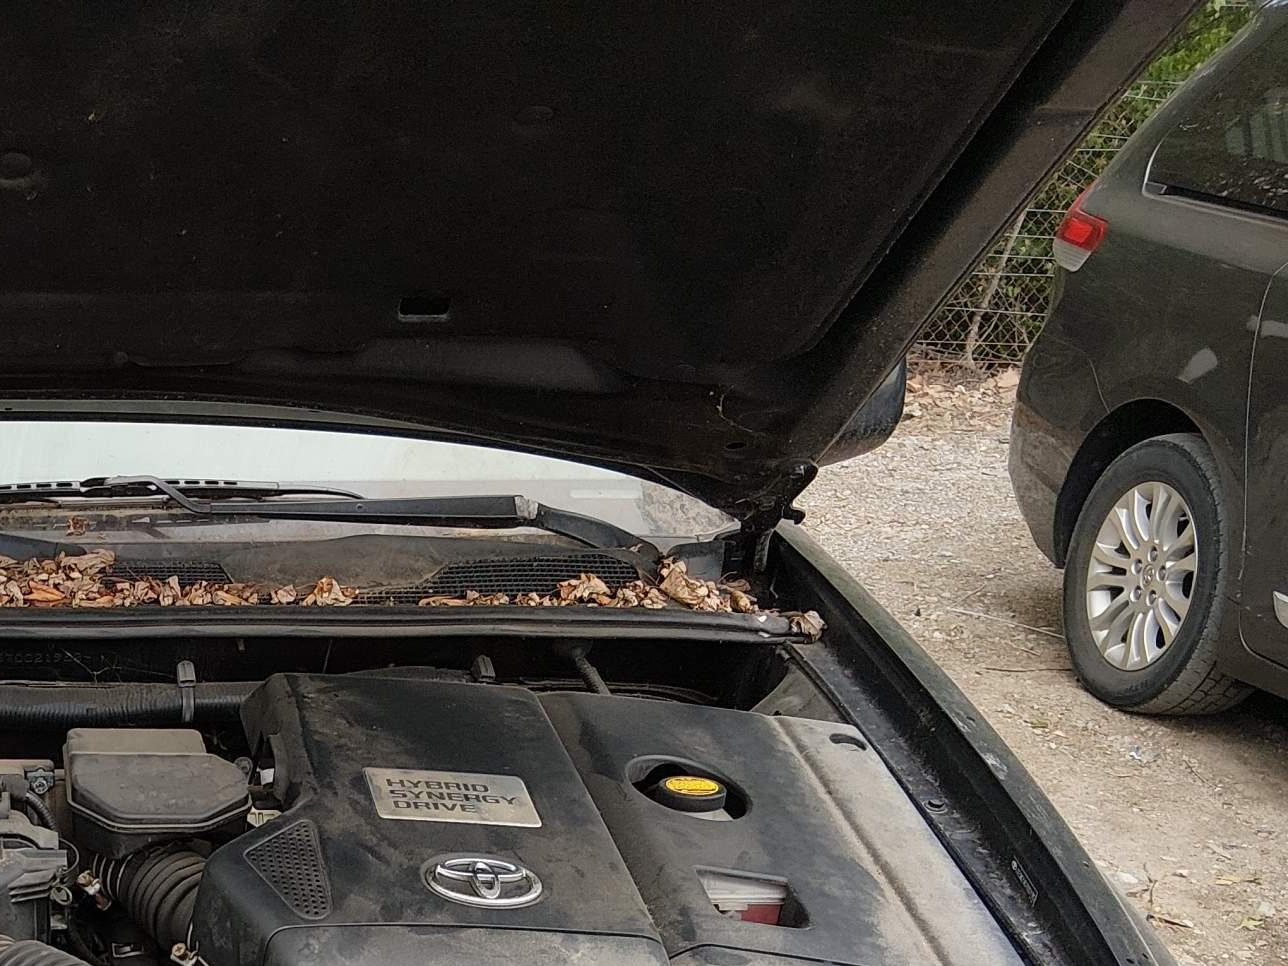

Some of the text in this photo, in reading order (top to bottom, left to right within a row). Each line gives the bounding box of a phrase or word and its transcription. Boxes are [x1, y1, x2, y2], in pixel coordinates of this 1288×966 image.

[385, 778, 489, 793] HYBRID
[389, 789, 517, 805] SYNERGY
[393, 801, 477, 813] DRIVE
